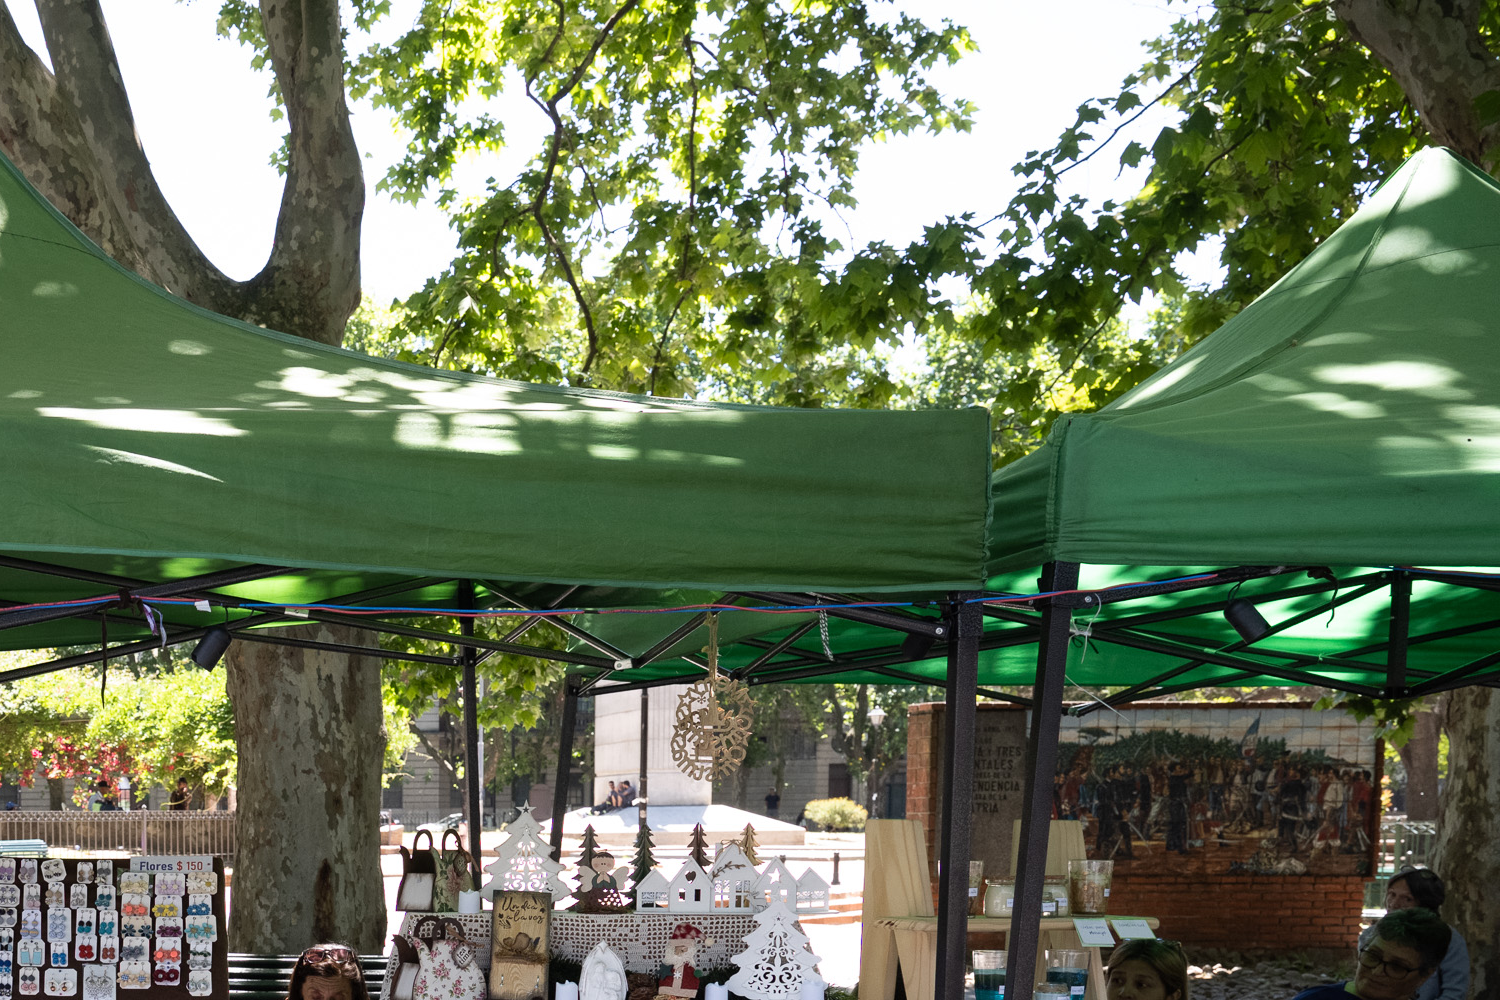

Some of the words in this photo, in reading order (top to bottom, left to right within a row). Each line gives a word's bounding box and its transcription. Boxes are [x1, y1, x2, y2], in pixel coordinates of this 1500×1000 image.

[996, 746, 1022, 757] TRES
[139, 861, 173, 871] Flores
[176, 860, 183, 872] $
[186, 861, 203, 871] 150
